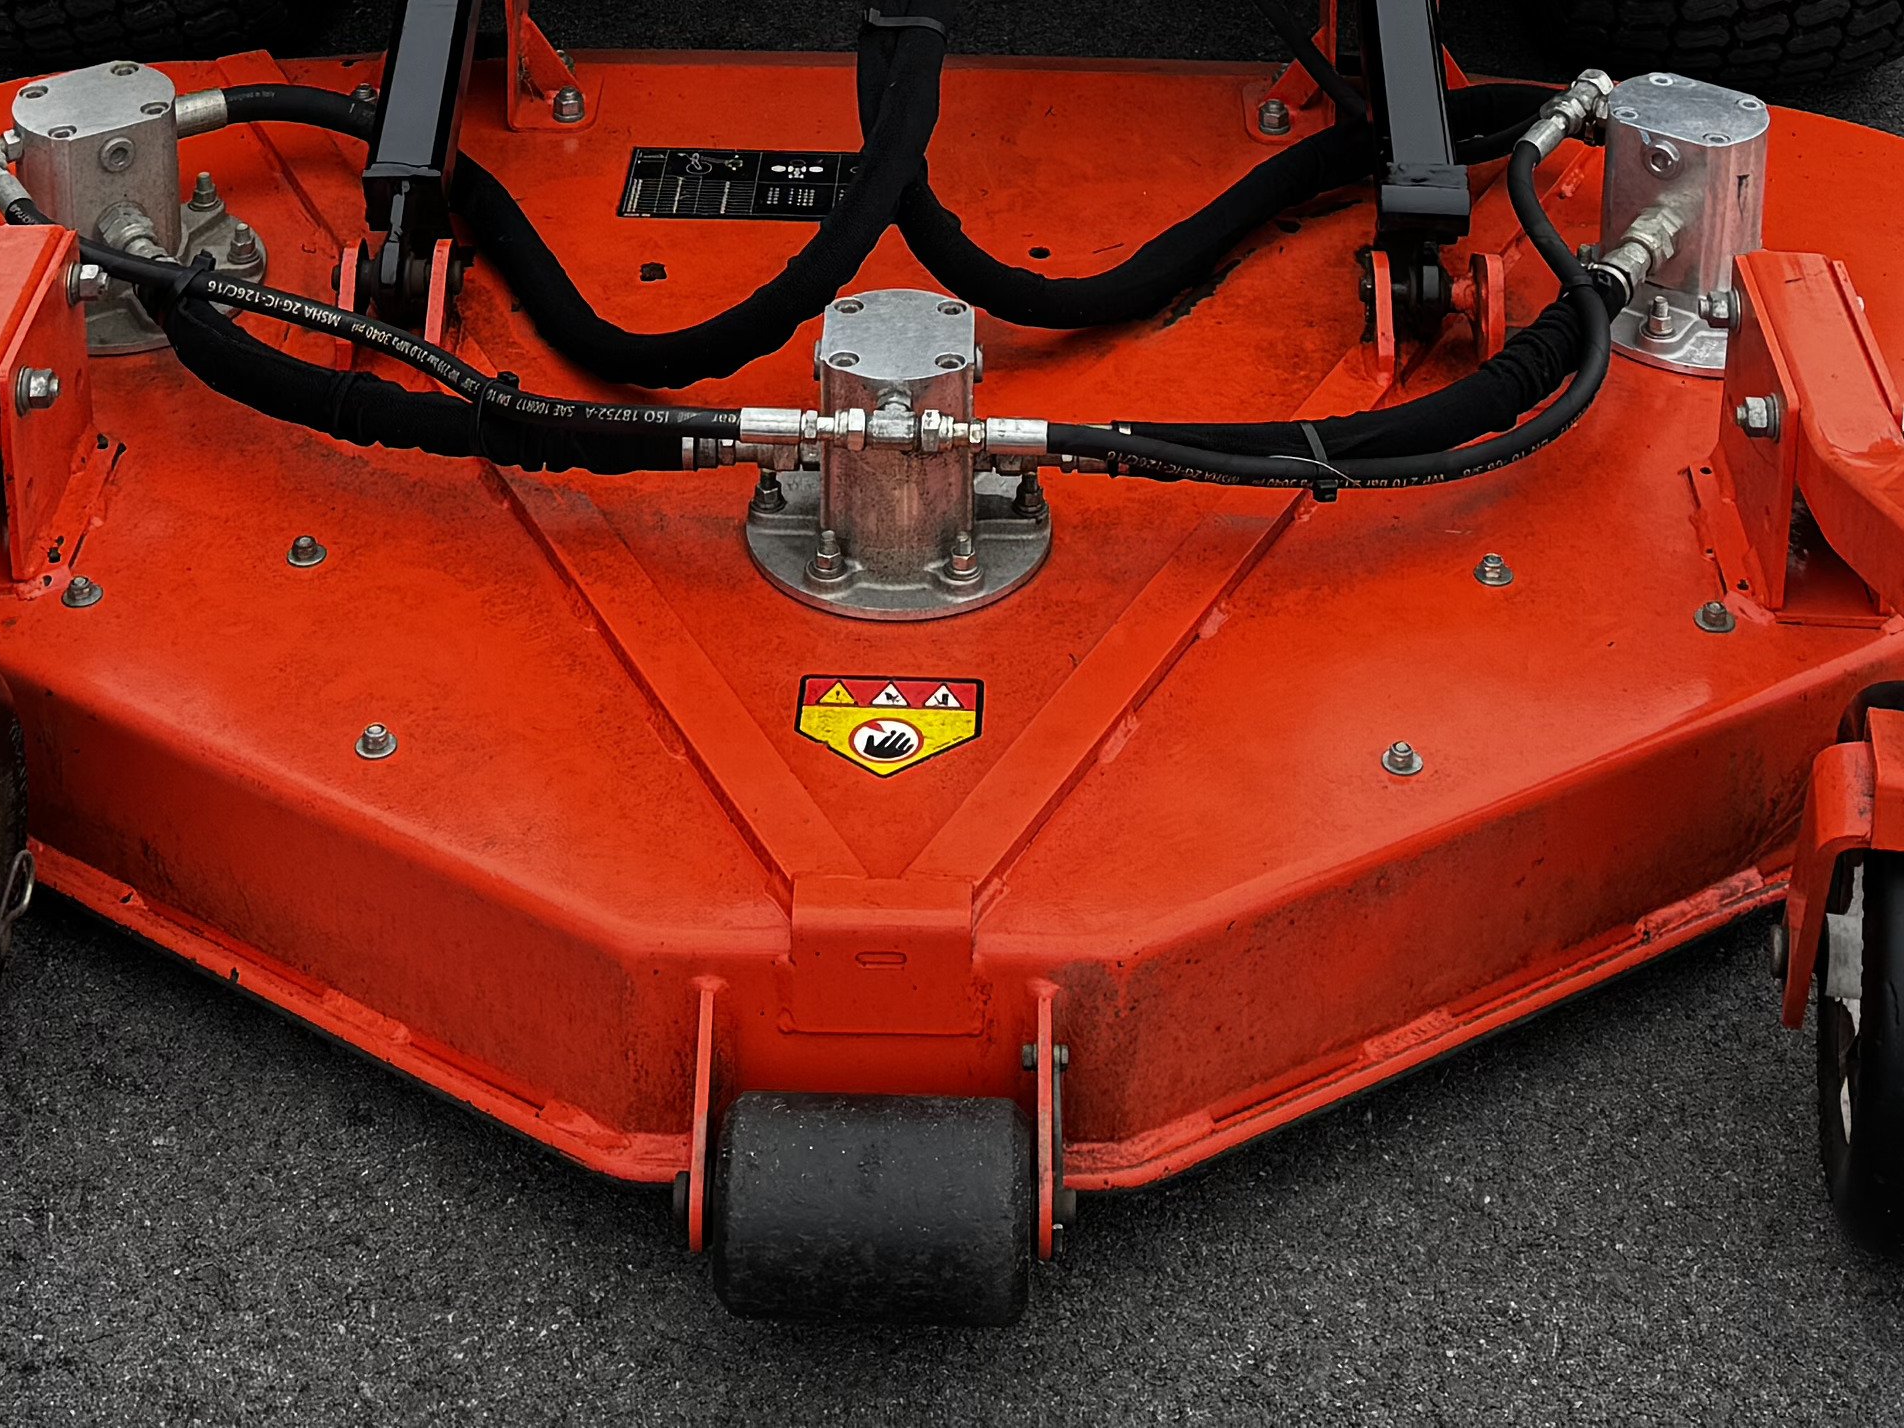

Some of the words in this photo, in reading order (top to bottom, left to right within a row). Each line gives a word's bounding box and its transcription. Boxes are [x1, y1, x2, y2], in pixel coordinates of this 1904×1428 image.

[303, 305, 342, 327] MSHA
[366, 325, 390, 346] 3040
[585, 407, 639, 422] 18752-A
[644, 410, 670, 424] ISO
